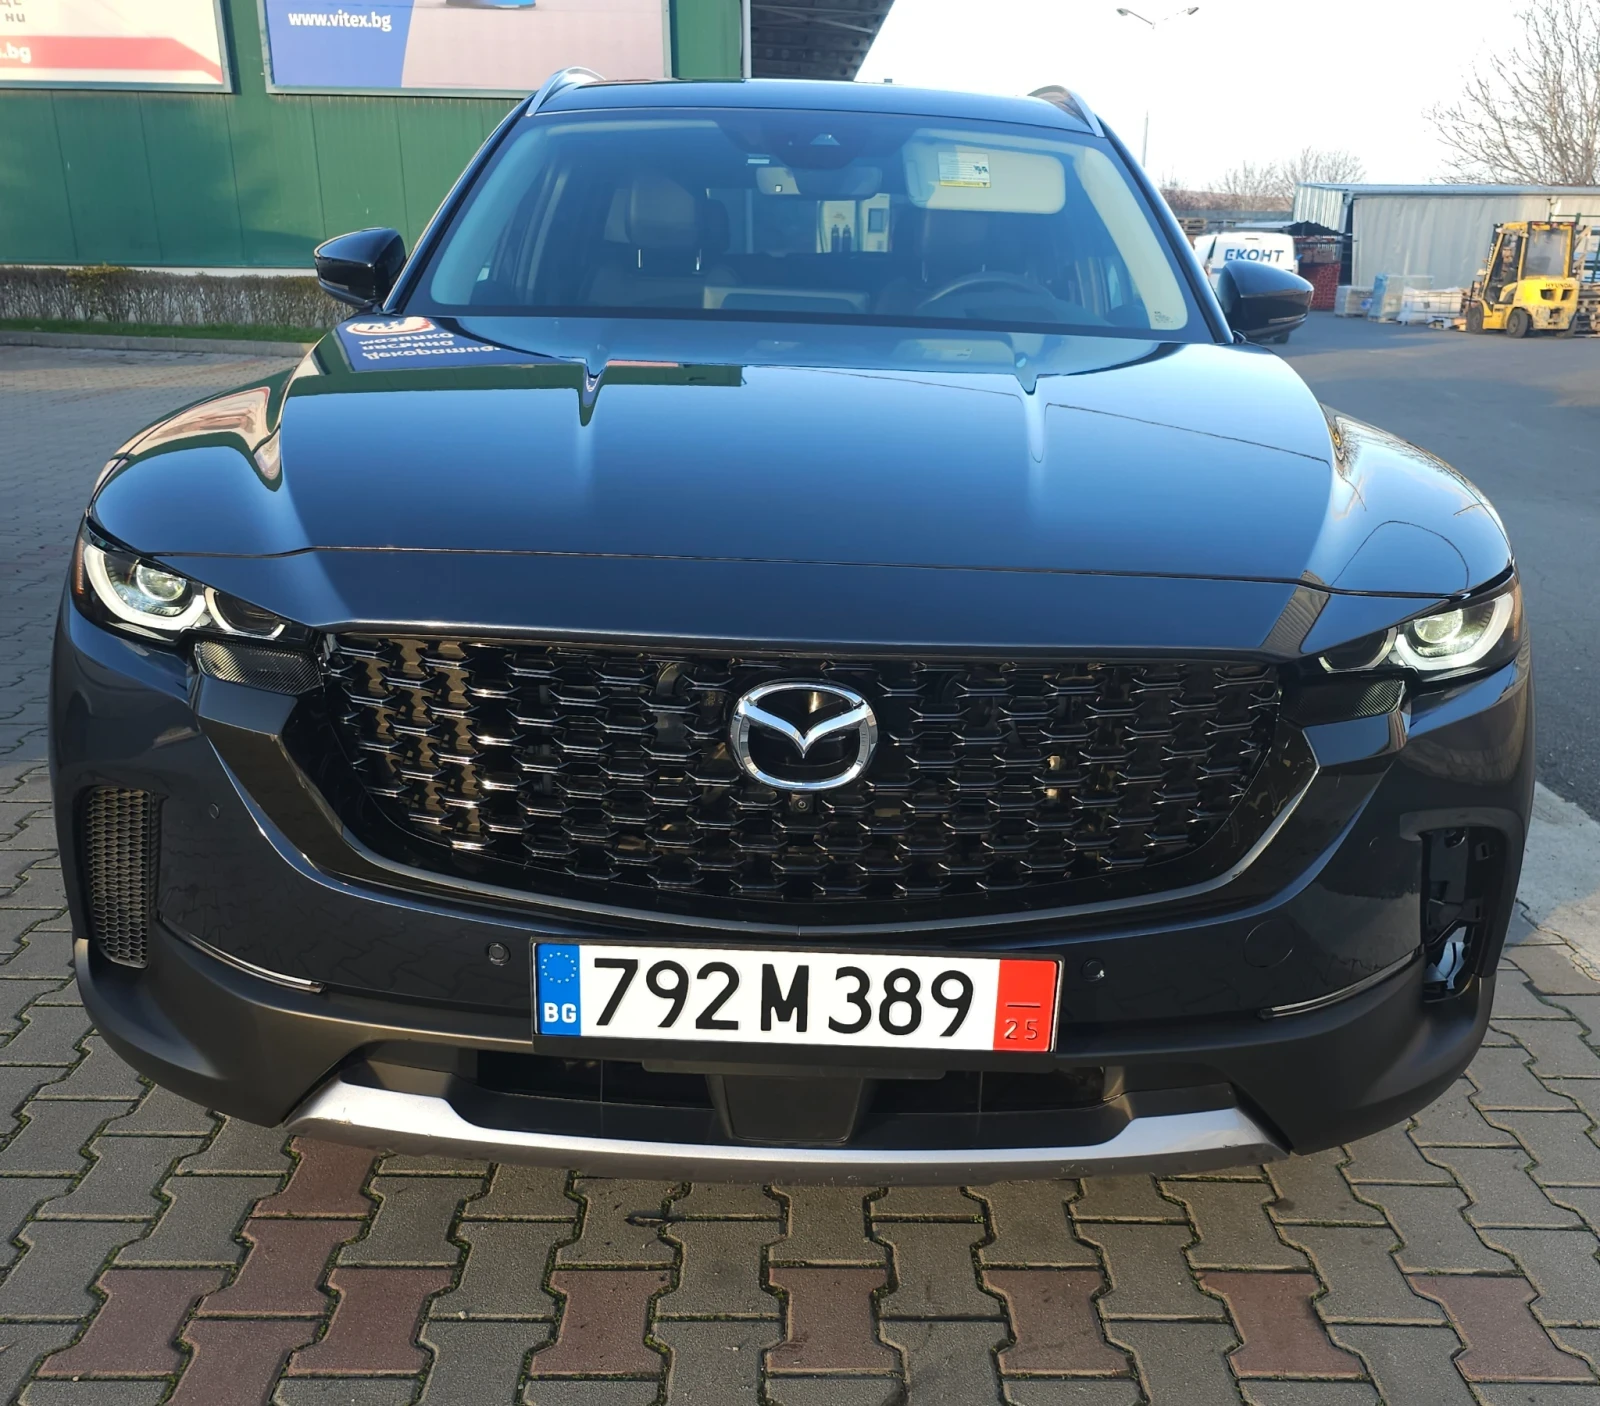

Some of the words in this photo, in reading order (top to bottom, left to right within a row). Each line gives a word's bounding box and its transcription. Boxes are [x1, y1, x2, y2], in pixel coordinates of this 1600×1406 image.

[288, 9, 392, 32] www.vitex.bg
[0, 41, 32, 64] .bg
[1224, 248, 1284, 262] ЕКОНТ
[594, 957, 740, 1031] 792
[760, 963, 810, 1033] M
[828, 965, 975, 1038] 389
[543, 1002, 577, 1024] BG
[1004, 1018, 1038, 1040] 25
